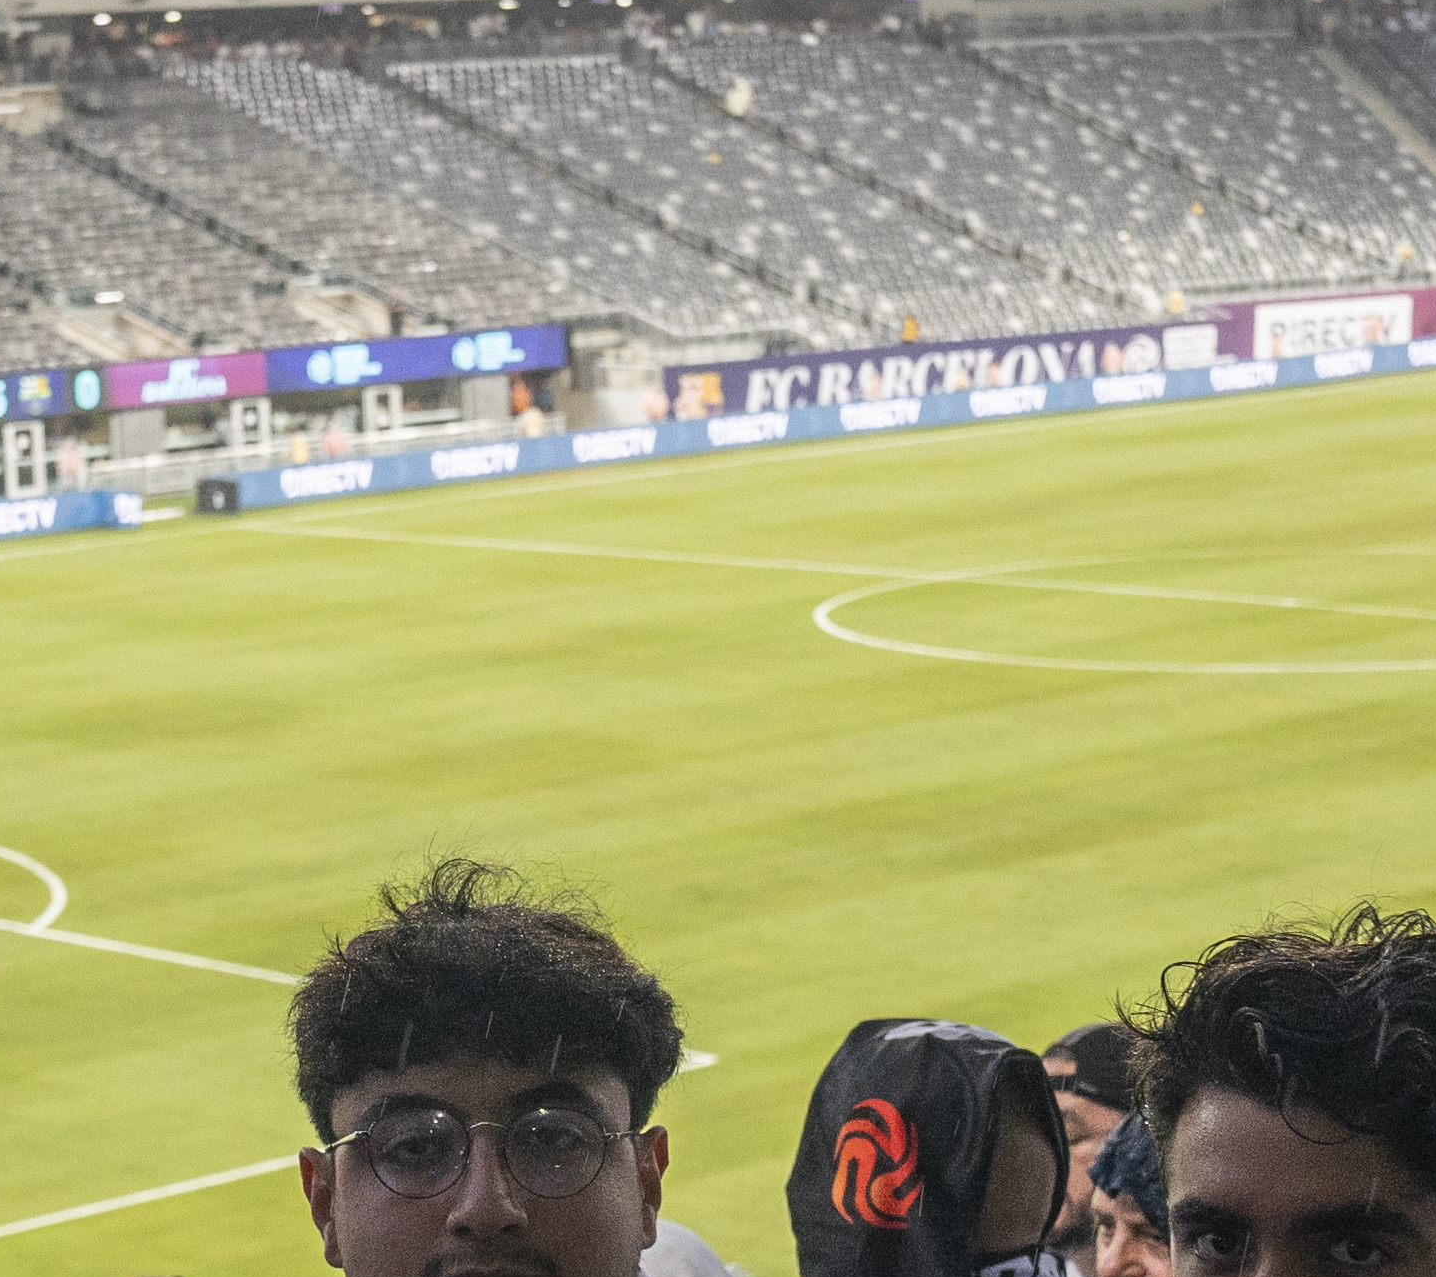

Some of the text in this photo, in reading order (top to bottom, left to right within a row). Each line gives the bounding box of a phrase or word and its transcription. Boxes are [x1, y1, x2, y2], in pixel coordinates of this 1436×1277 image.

[74, 369, 101, 411] 0
[745, 363, 811, 414] FC
[818, 339, 1096, 405] BARCELONA
[281, 460, 374, 497] DIRECTV
